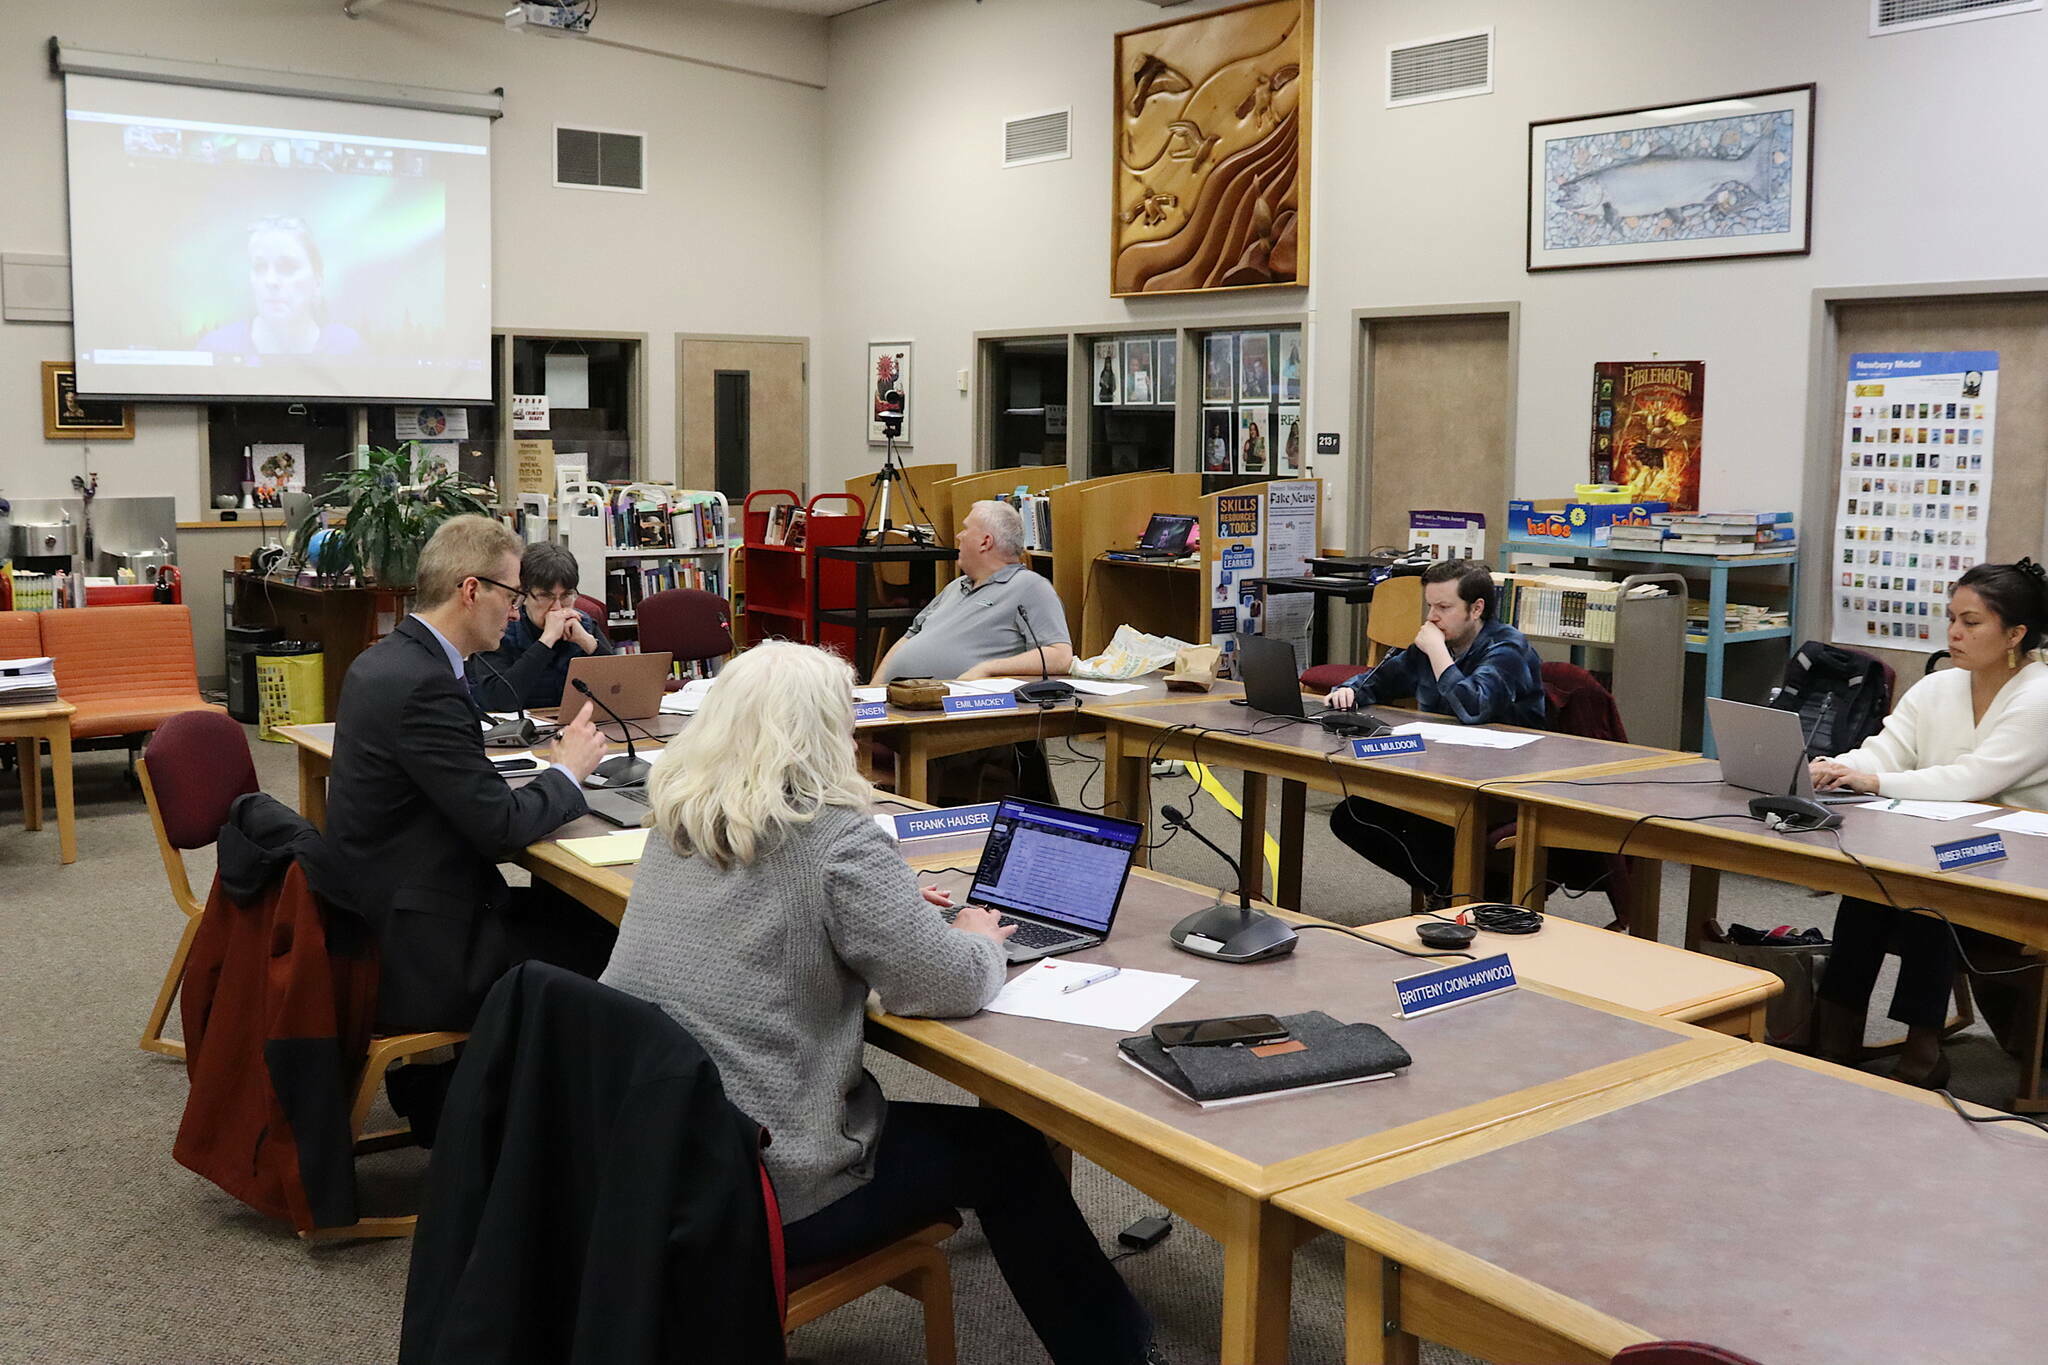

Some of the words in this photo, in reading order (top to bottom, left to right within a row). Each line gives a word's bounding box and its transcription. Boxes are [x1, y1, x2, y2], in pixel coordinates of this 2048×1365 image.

[1624, 366, 1694, 395] FABLEHAVEN
[1281, 414, 1300, 425] REA
[1319, 436, 1332, 446] 213
[1220, 498, 1257, 512] SKILLS
[1270, 492, 1290, 504] Fake
[1290, 492, 1315, 505] News
[1220, 512, 1256, 522] RESOURCES
[1220, 523, 1229, 537] &
[1229, 522, 1257, 534] TOOLS
[1527, 517, 1571, 537] halos
[1224, 559, 1253, 568] LEARNER
[955, 700, 974, 709] EMIL
[974, 698, 1005, 707] MACKEY
[1362, 744, 1380, 753] WILL
[1380, 740, 1417, 751] MULDOON
[909, 820, 945, 832] FRANK
[947, 813, 989, 827] HAUSER
[1400, 983, 1443, 1005] BRITTENY
[1445, 965, 1512, 993] CIONI-HAYWOOD
